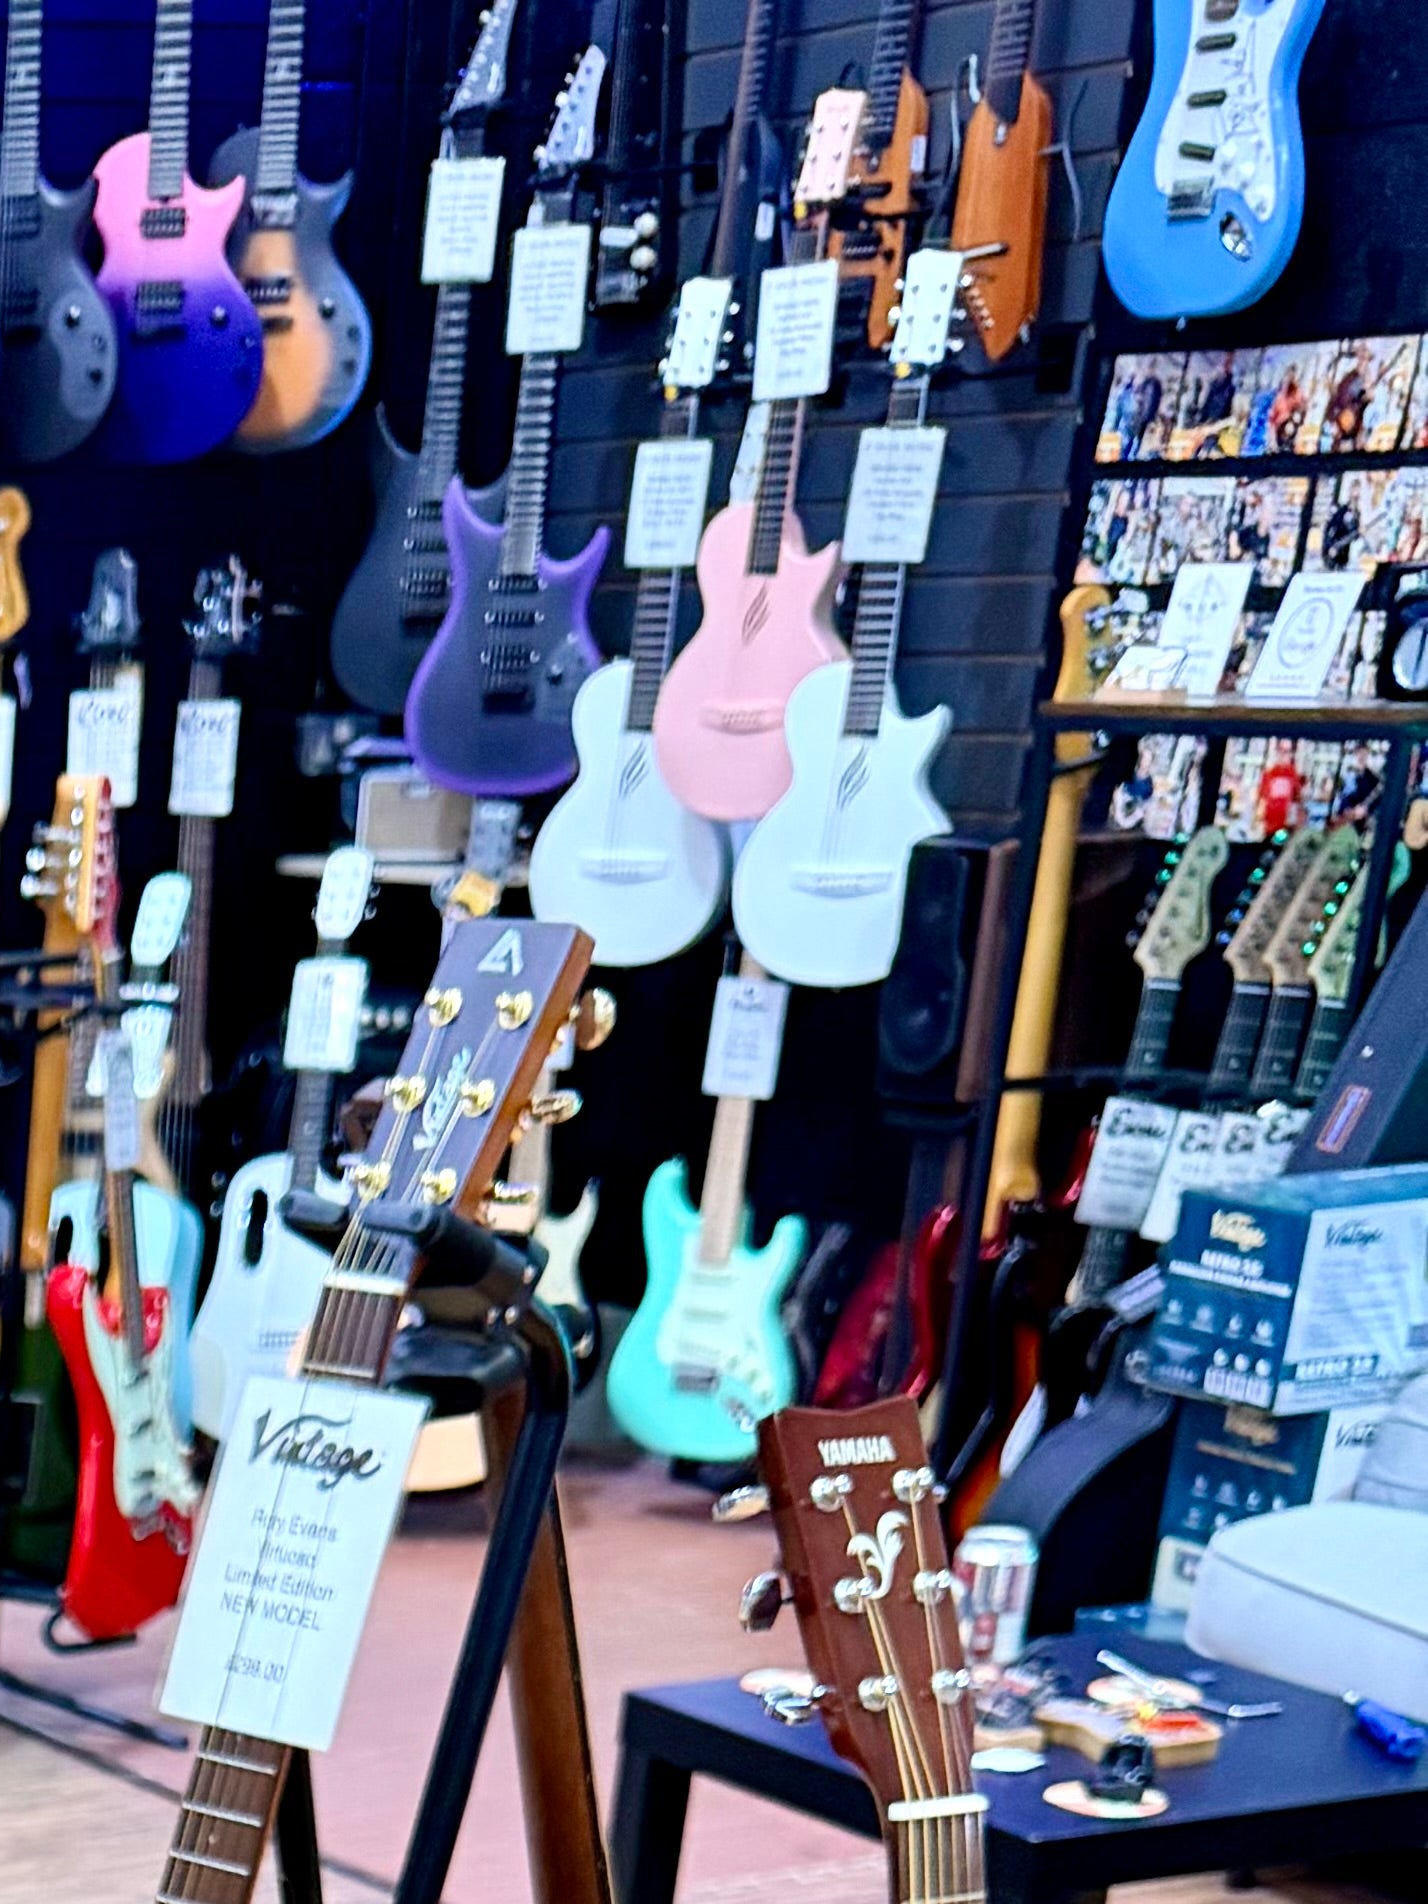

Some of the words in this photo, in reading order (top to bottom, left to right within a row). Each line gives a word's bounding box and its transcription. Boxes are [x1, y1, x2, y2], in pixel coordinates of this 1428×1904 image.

[248, 1408, 383, 1491] Vintage
[817, 1435, 897, 1468] YAMAHA
[260, 1603, 322, 1632] MODEL
